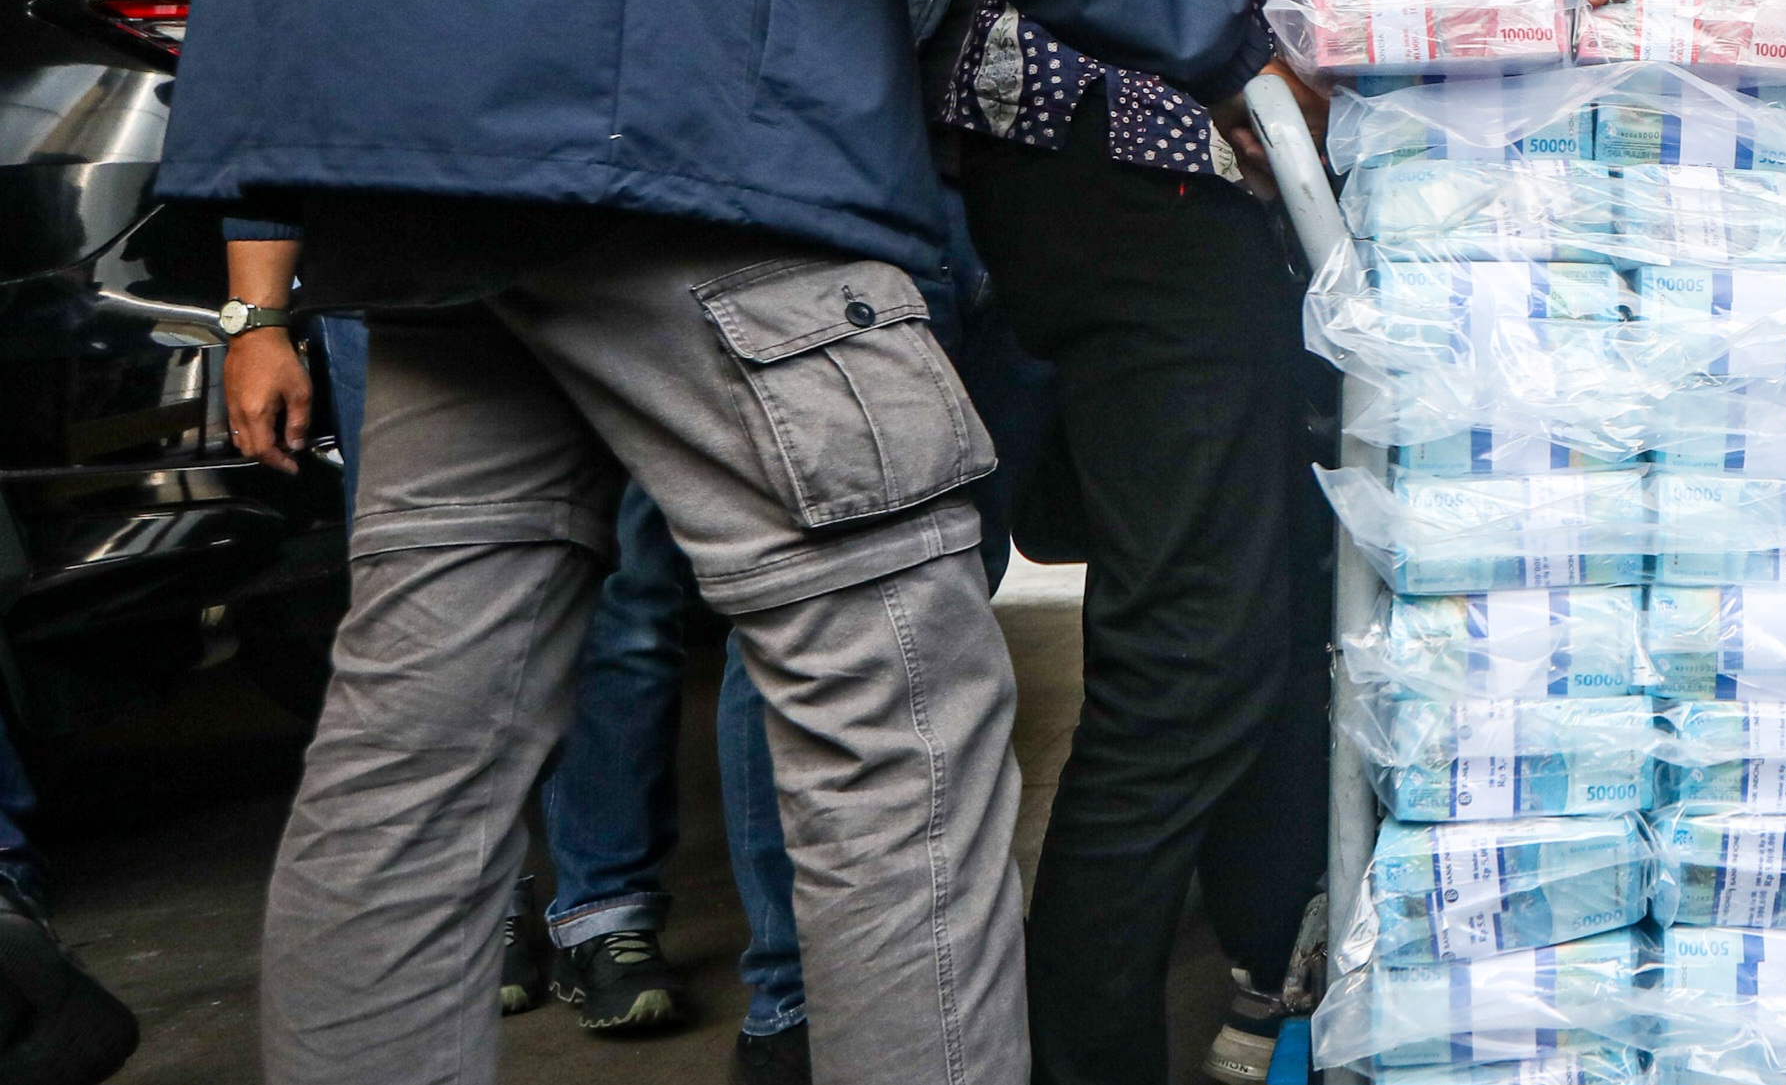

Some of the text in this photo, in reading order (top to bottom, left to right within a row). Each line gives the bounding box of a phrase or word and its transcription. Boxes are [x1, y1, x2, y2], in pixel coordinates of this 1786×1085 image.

[1501, 28, 1554, 42] 100000
[1529, 138, 1577, 153] 50000
[1656, 276, 1705, 292] 50000
[1574, 673, 1624, 688] 50000
[1587, 783, 1637, 801] 50000
[1764, 874, 1774, 887] Rp
[1572, 909, 1623, 930] 50000
[1678, 940, 1729, 957] 50000
